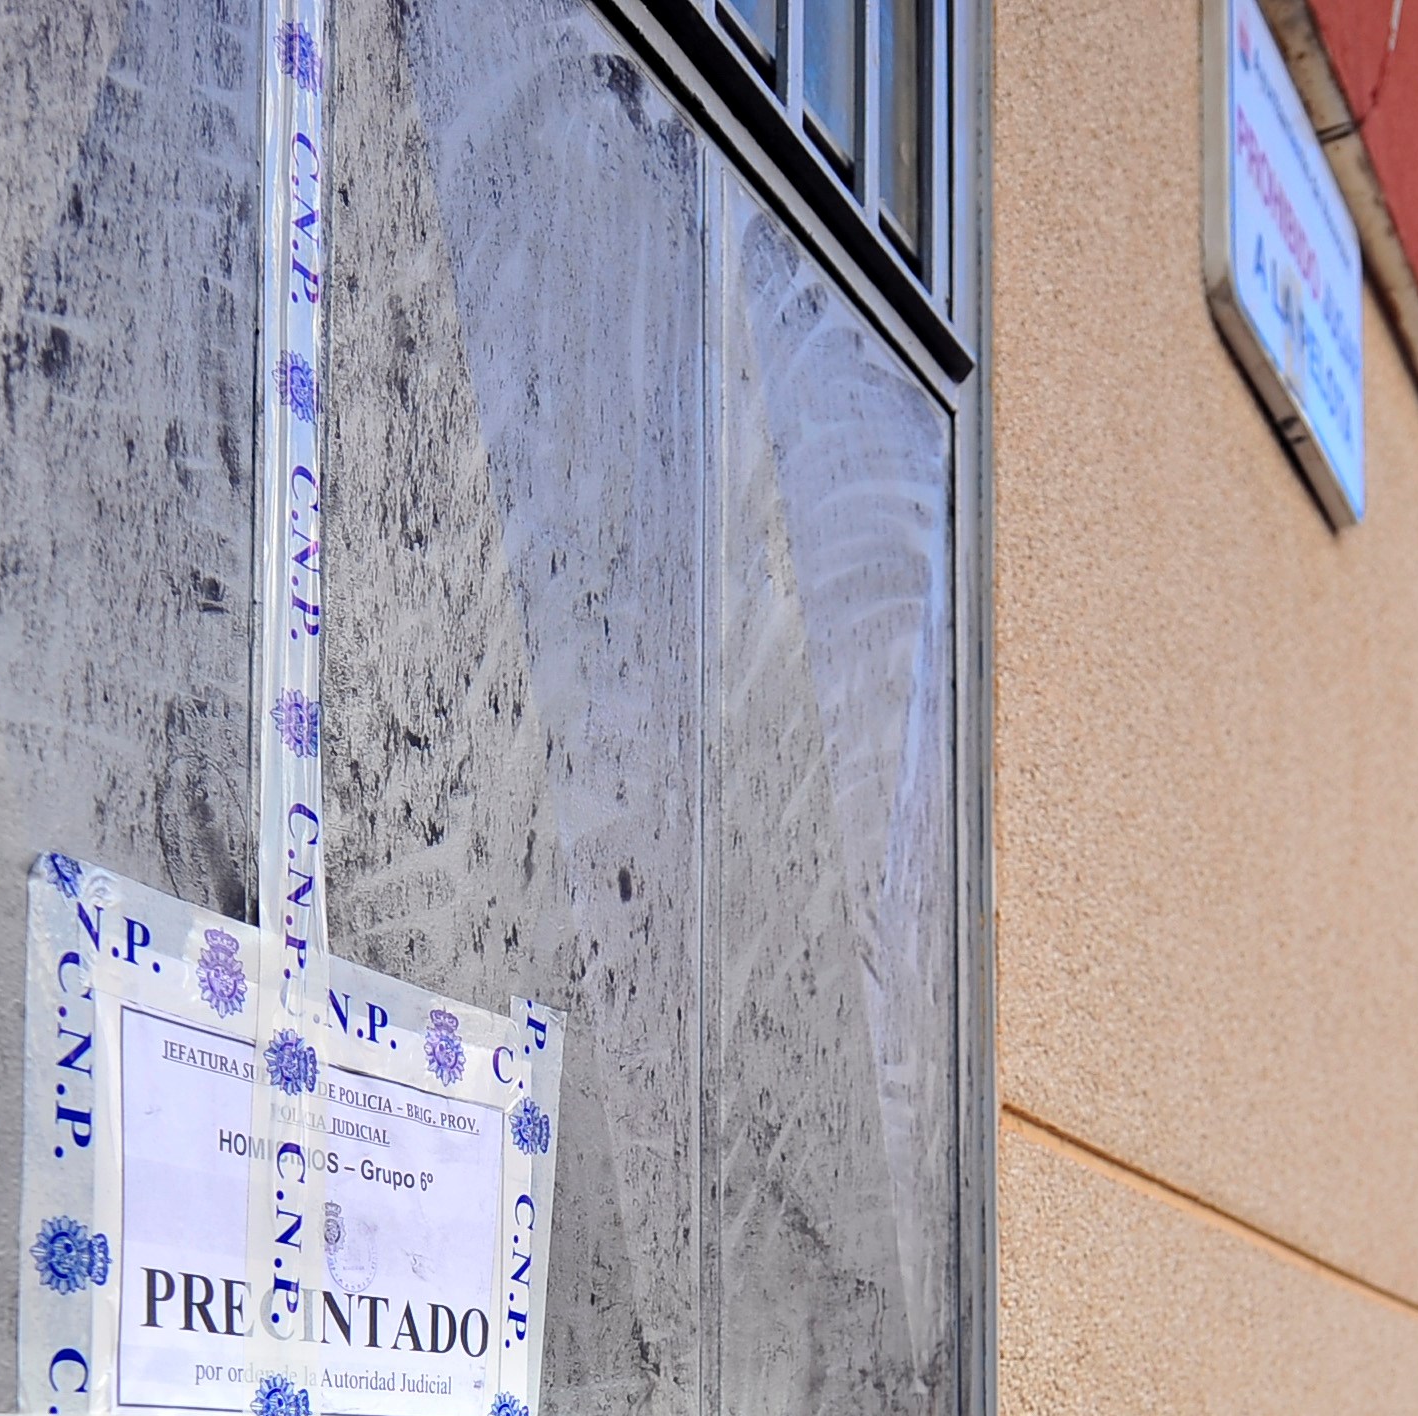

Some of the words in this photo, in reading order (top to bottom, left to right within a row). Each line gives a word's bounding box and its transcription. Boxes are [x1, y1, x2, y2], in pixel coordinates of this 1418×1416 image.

[290, 131, 320, 304] C.N.P.
[290, 464, 320, 640] C.N.P.
[284, 802, 319, 980] C.N.P.
[54, 950, 93, 1159] C.N.P.
[162, 1039, 239, 1076] JEFATURA
[318, 1080, 337, 1100] DE
[339, 1086, 393, 1114] POLICIA
[406, 1103, 437, 1125] BRIG.
[440, 1112, 481, 1134] PROV.
[331, 1117, 391, 1146] JUDICIAL
[270, 1141, 307, 1325] C.N.P.
[360, 1158, 416, 1191] Grupo
[140, 1266, 490, 1358] PRECINTADO
[503, 1193, 536, 1349] C.N.P.
[195, 1363, 223, 1386] por
[320, 1368, 395, 1392] Autoridad
[399, 1373, 452, 1395] Judicial
